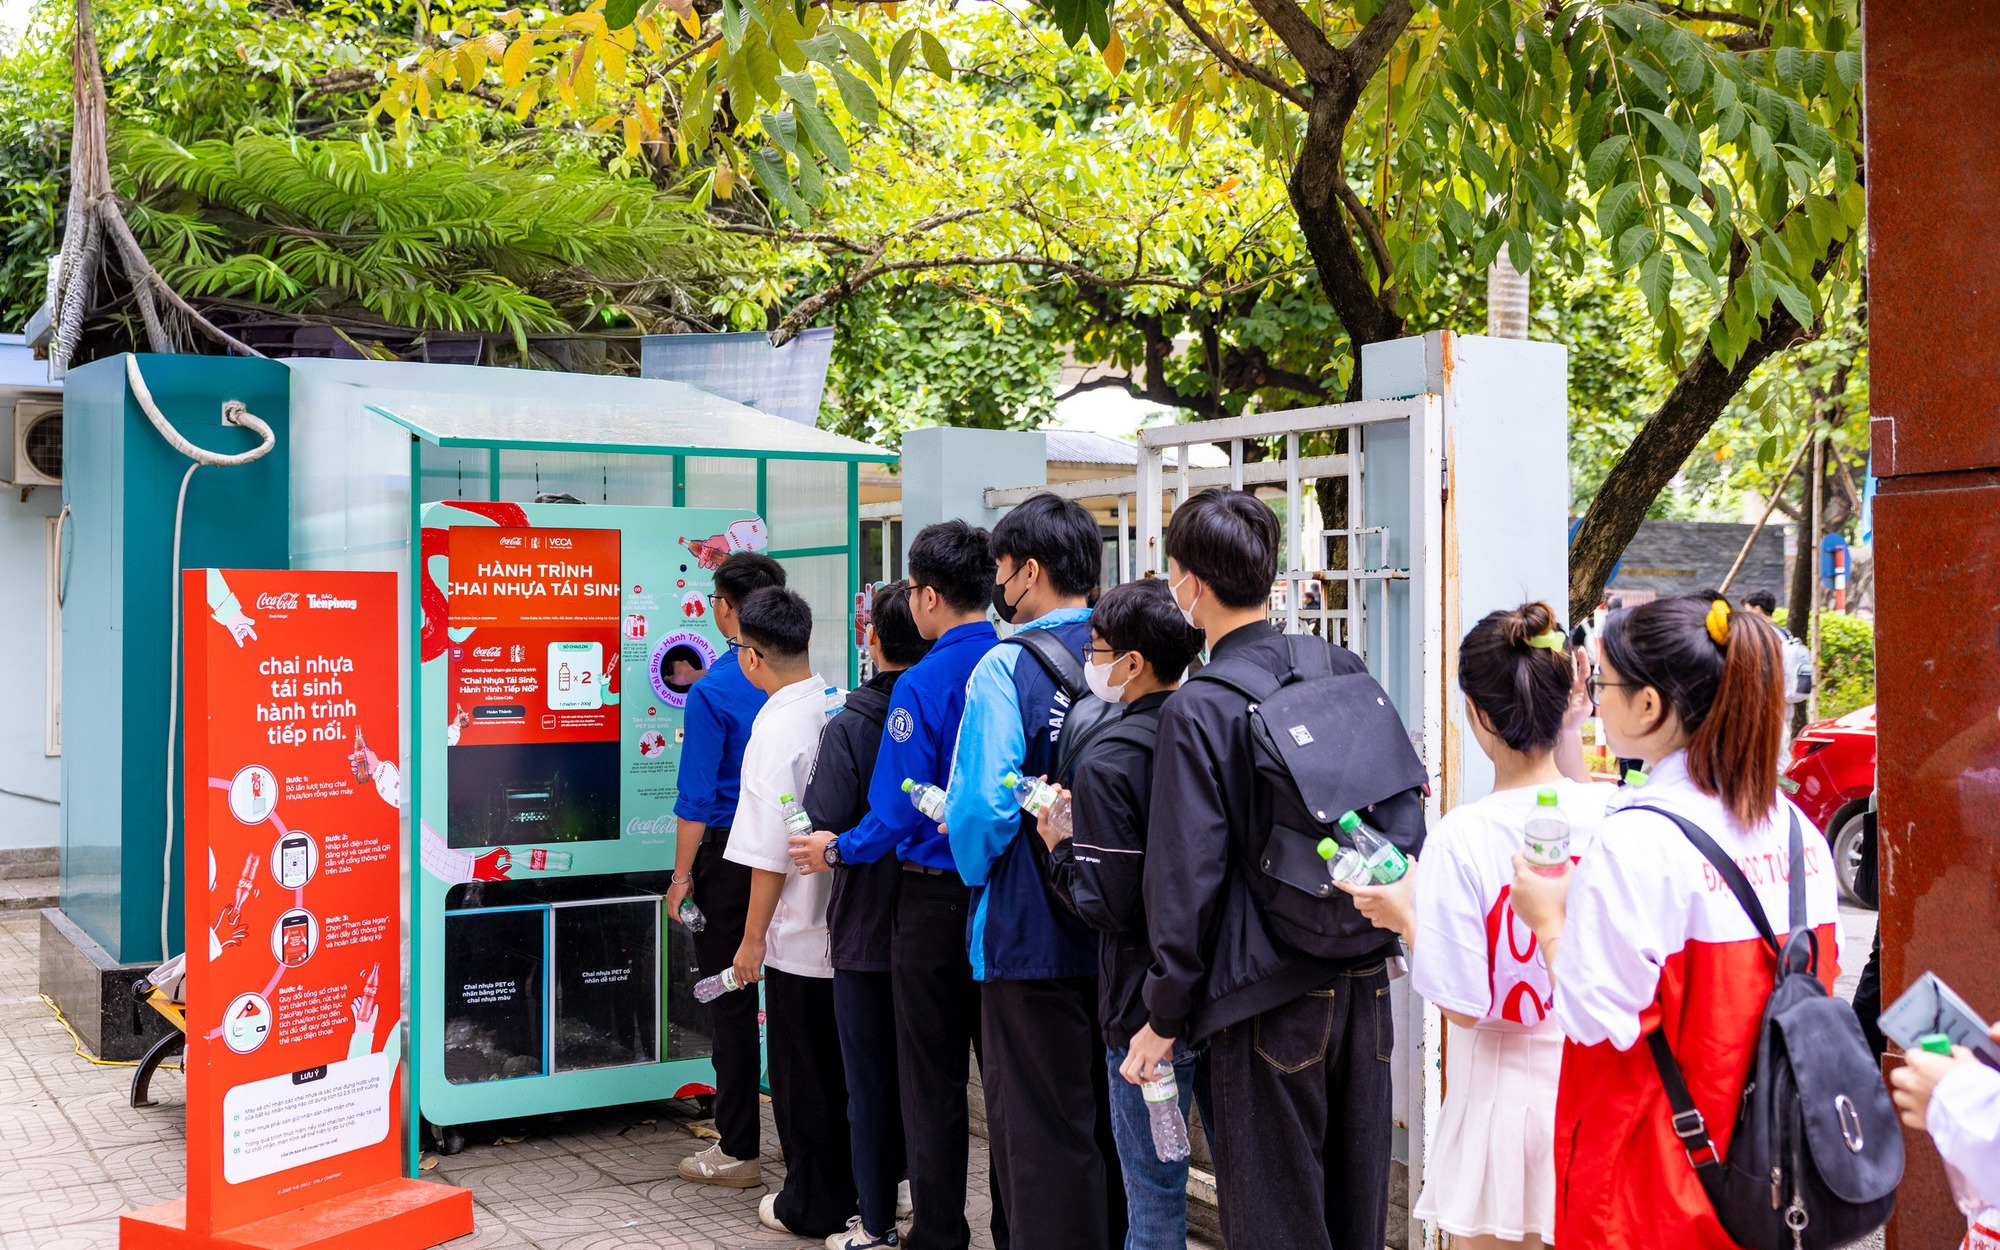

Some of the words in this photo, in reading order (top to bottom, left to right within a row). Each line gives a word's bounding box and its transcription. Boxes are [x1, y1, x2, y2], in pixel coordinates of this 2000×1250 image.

[478, 560, 531, 576] HÀNH
[538, 561, 592, 577] TRÌNH
[493, 581, 545, 600] NHỰA
[551, 580, 577, 595] TÁI
[256, 592, 300, 610] Coca-Cola
[663, 633, 685, 647] Hành
[689, 634, 709, 650] Trình
[473, 646, 502, 657] Coca-Cola
[259, 656, 300, 674] chai
[306, 656, 353, 676] nhựa
[651, 652, 661, 673] Sinh
[582, 671, 591, 683] 2
[652, 677, 661, 690] Tái
[271, 680, 296, 697] tái
[303, 678, 342, 696] sinh
[662, 689, 682, 705] Nhựa
[256, 702, 304, 721] hành
[312, 699, 356, 718] trình
[268, 724, 306, 746] tiếp
[312, 721, 346, 740] nối.
[286, 792, 312, 800] nhựa/lon
[364, 838, 378, 847] thoại
[349, 848, 356, 856] và
[326, 858, 336, 866] dẫn
[361, 919, 371, 928] Gia
[326, 932, 338, 940] điền
[351, 928, 359, 937] đủ
[360, 926, 377, 936] thông
[378, 925, 386, 934] tin
[279, 986, 295, 994] Bước
[290, 1000, 307, 1009] thành
[322, 995, 331, 1004] rút
[320, 1004, 332, 1014] tiếp
[332, 1002, 342, 1011] tục
[279, 1020, 290, 1028] tích
[291, 1015, 315, 1025] chai/lon
[289, 1025, 298, 1034] đủ
[299, 1024, 307, 1032] để
[331, 1017, 348, 1025] thành
[279, 1036, 289, 1044] thẻ
[300, 1071, 313, 1080] LƯU
